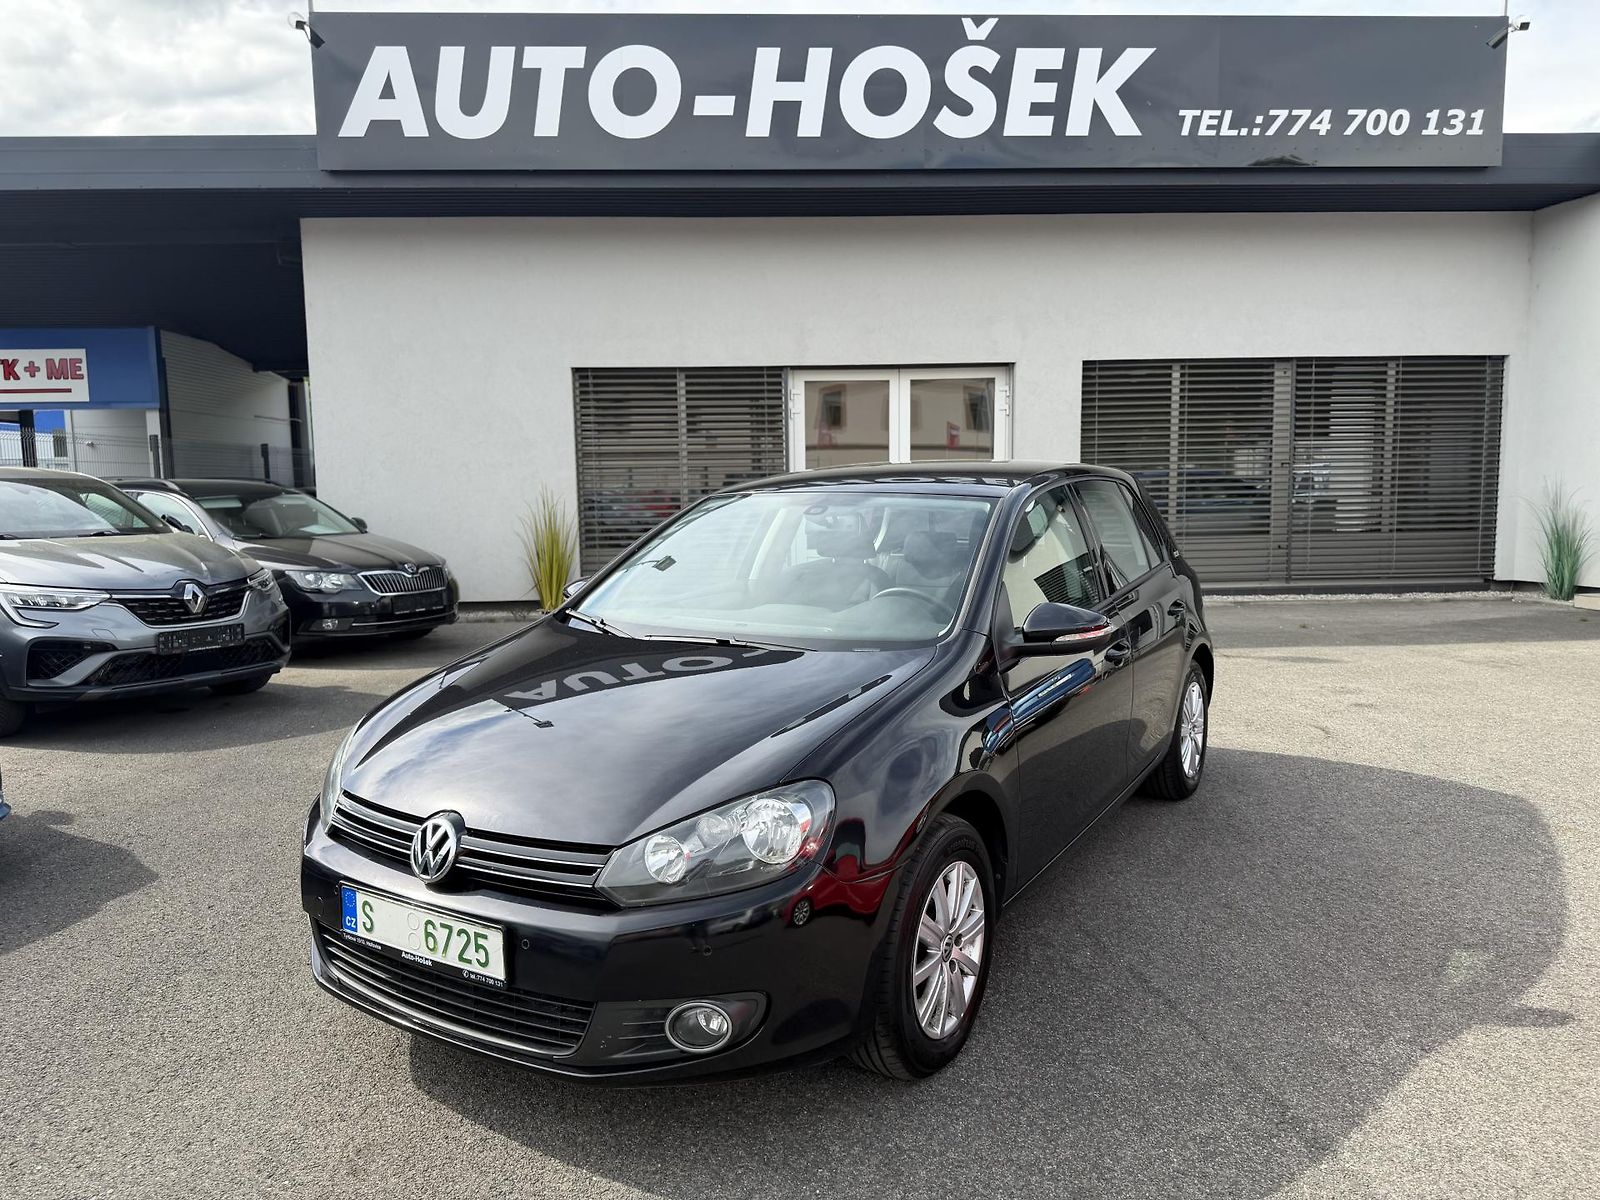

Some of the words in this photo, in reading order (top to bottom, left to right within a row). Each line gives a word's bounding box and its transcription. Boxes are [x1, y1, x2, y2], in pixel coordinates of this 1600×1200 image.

[337, 17, 1156, 140] AUTO-HOŠEK
[1178, 109, 1331, 136] TEL.:774
[1343, 108, 1410, 136] 700
[1421, 108, 1485, 136] 131
[45, 358, 84, 380] ME
[345, 915, 356, 928] CZ
[362, 900, 374, 933] S
[424, 919, 490, 968] 6725
